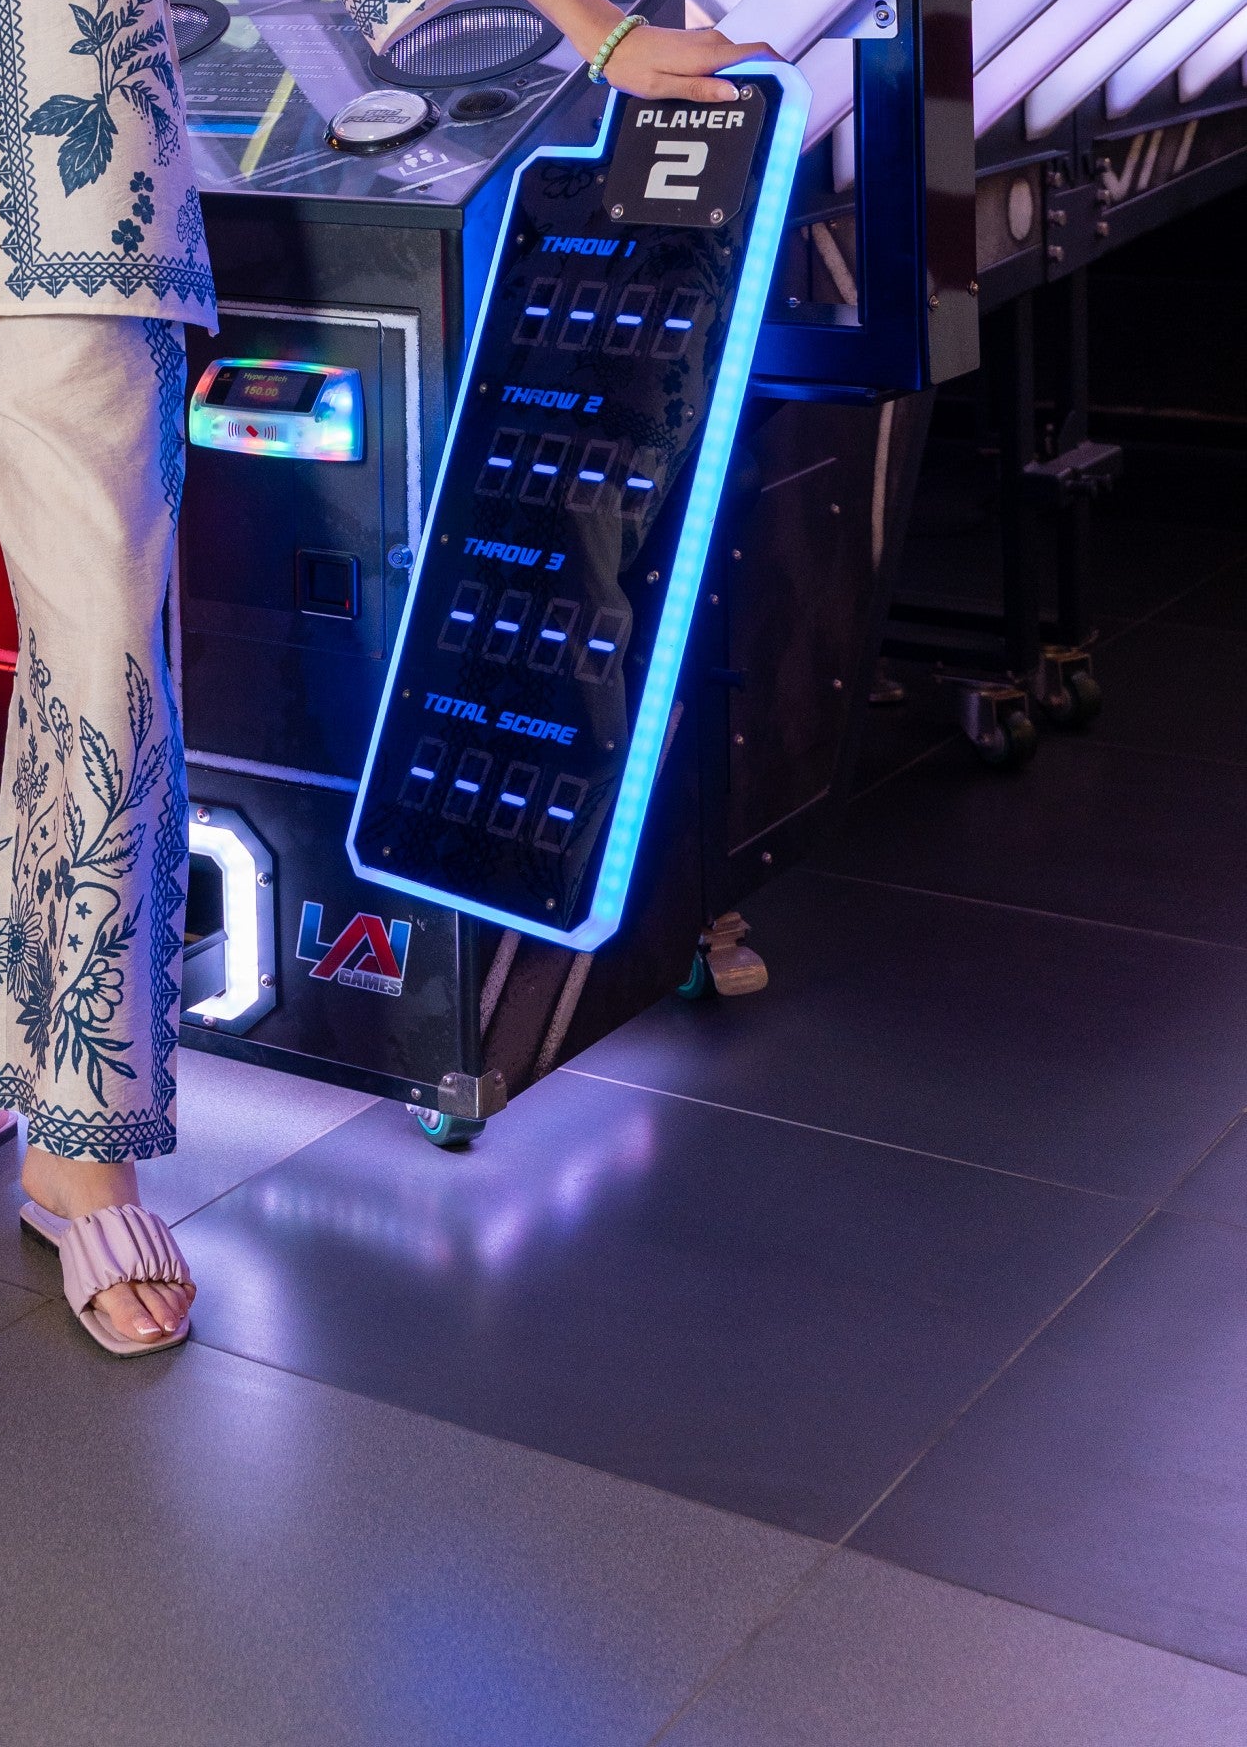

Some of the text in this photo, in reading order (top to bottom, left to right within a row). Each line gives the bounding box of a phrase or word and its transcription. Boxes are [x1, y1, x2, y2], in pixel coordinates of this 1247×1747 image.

[243, 24, 361, 32] INSTRUCTIO
[636, 109, 745, 129] PLAYER
[643, 140, 709, 201] 2
[541, 236, 637, 257] THROW 1
[243, 372, 266, 382] Hyper
[267, 374, 288, 384] pitch
[502, 385, 604, 414] THROW 2
[464, 537, 565, 571] THROW 3
[424, 692, 577, 746] TOTAL SCORE
[296, 900, 412, 981] LAI
[338, 967, 403, 997] GAMES
